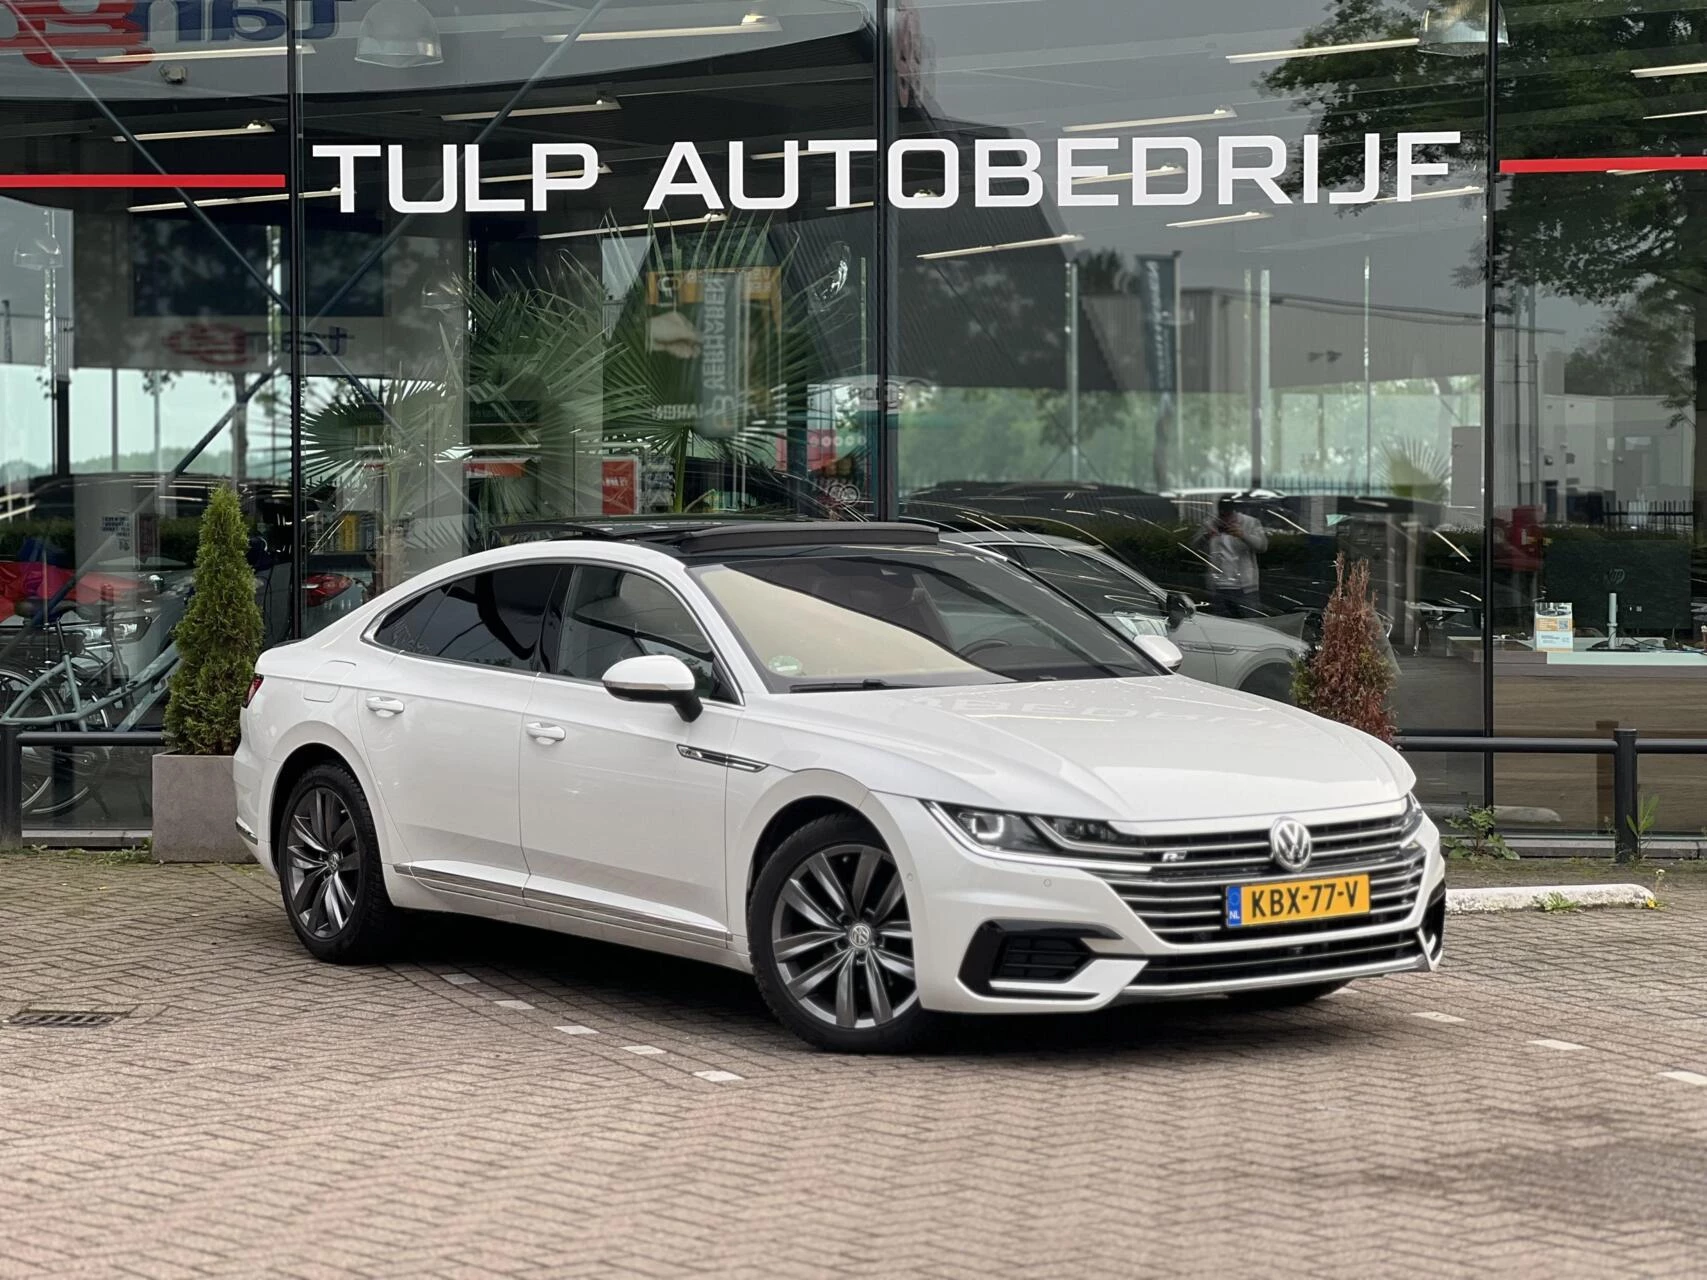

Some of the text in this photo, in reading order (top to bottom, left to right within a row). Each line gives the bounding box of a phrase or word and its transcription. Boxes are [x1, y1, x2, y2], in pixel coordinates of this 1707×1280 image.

[312, 131, 1461, 213] TULP AUTOBEDRIJF
[1229, 911, 1241, 920] NL
[1252, 880, 1358, 918] KBX-77-V
